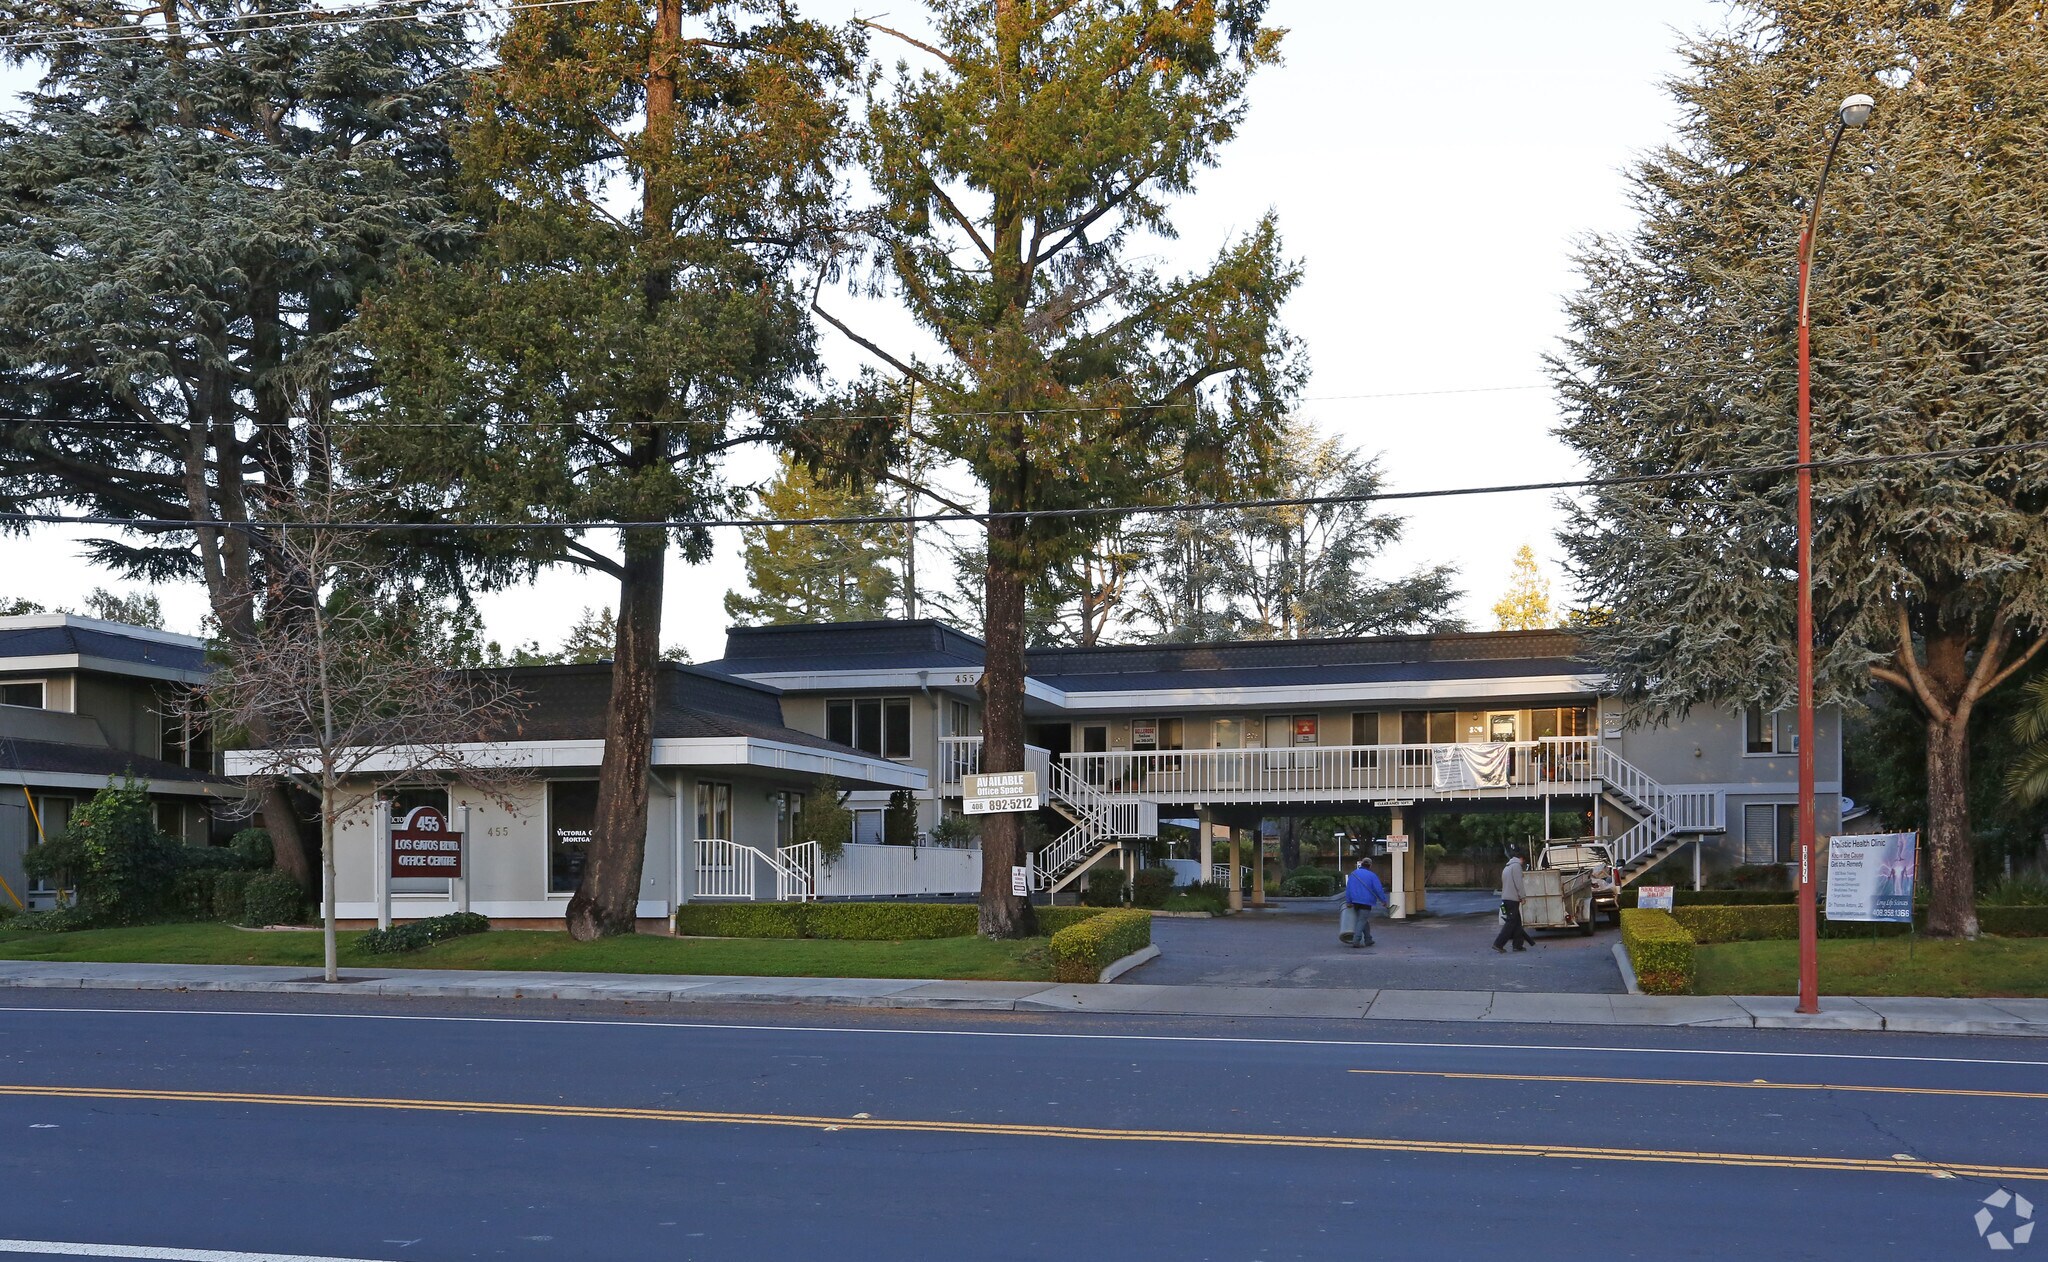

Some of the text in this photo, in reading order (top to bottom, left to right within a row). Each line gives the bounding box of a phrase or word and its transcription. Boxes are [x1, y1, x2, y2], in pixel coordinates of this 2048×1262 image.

[955, 674, 974, 683] 455
[977, 775, 1024, 787] AVAILABLE
[977, 786, 1024, 796] Office Space
[416, 816, 440, 832] 455
[487, 826, 509, 837] 455
[557, 828, 587, 836] VICTORIA
[395, 839, 460, 851] LOS GATOS BLVD.
[1831, 838, 1886, 848] Holistic Health Clinic
[1850, 851, 1864, 859] Cause
[398, 855, 457, 866] OFFICE CENTRE
[1846, 860, 1863, 868] Remedy
[1873, 909, 1910, 917] 408.358.1366
